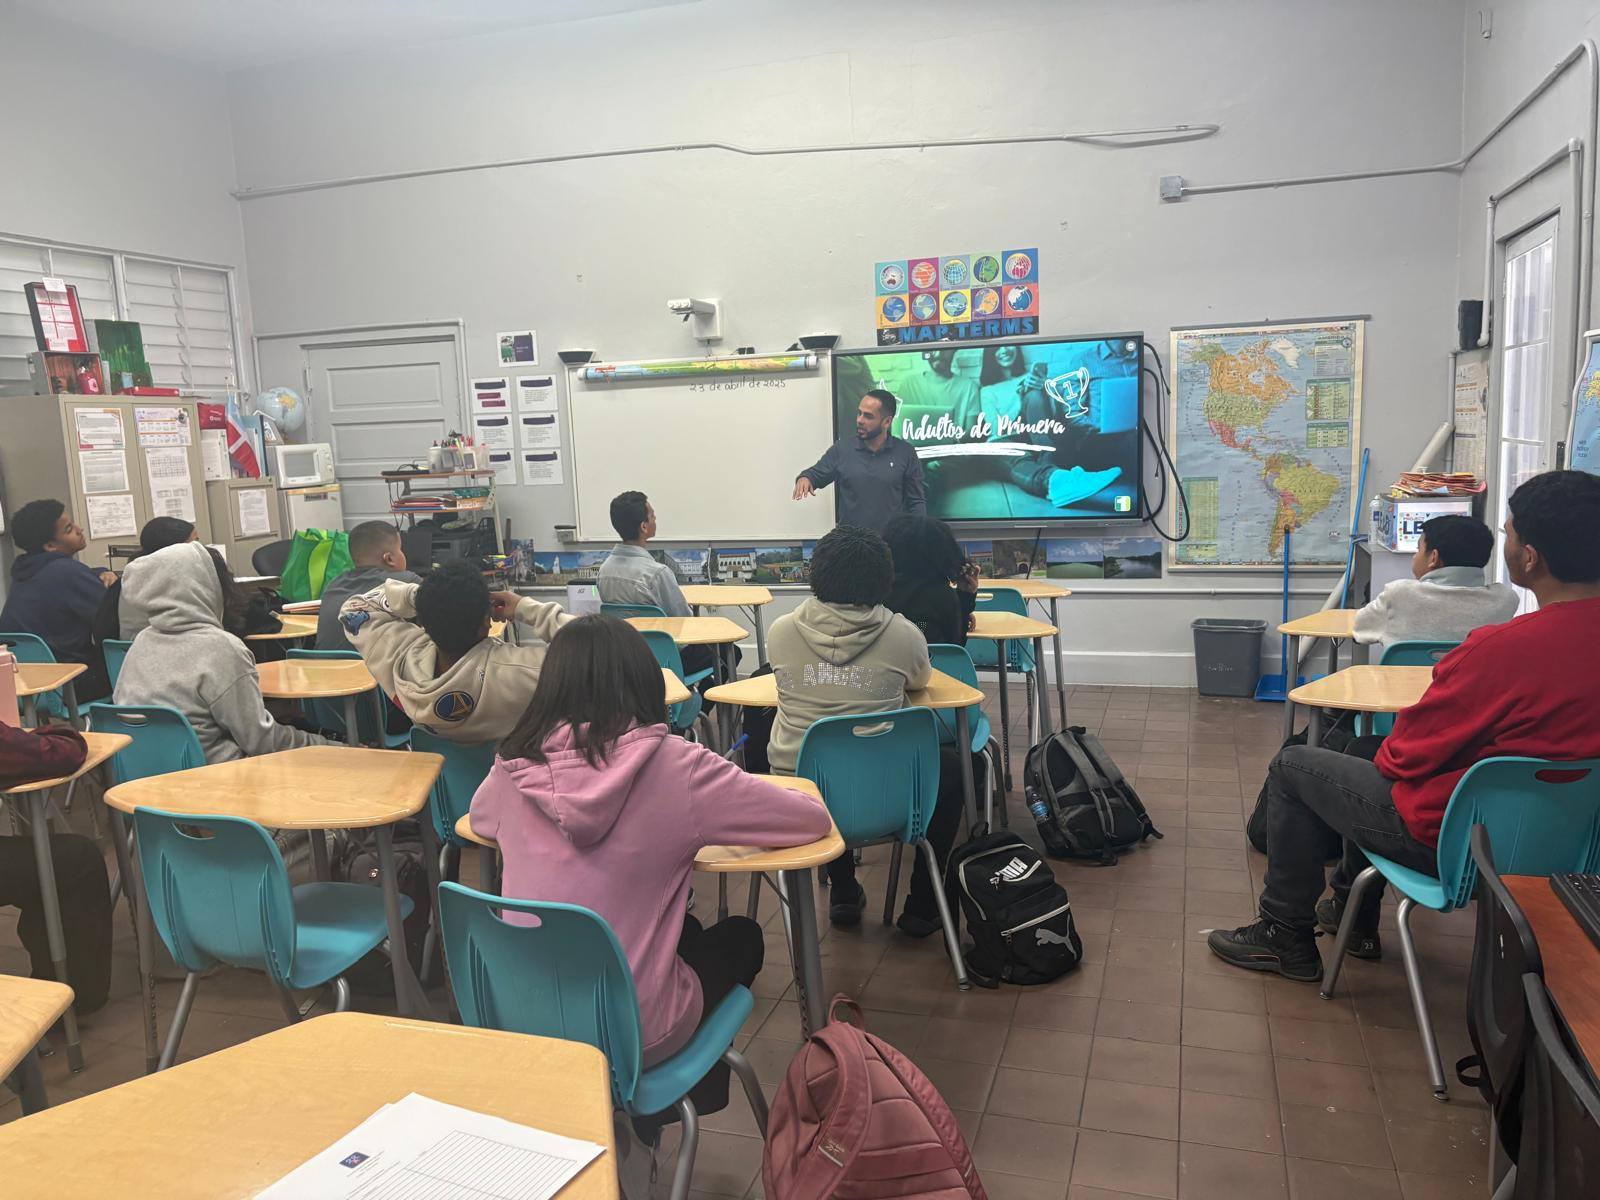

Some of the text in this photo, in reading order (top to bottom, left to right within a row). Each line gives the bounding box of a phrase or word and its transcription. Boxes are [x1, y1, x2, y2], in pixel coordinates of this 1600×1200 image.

[899, 317, 1034, 343] MAP TERMS
[689, 376, 786, 393] 23 de abril de 2025
[1063, 380, 1078, 400] 1
[970, 412, 992, 438] de
[997, 413, 1066, 436] Primera
